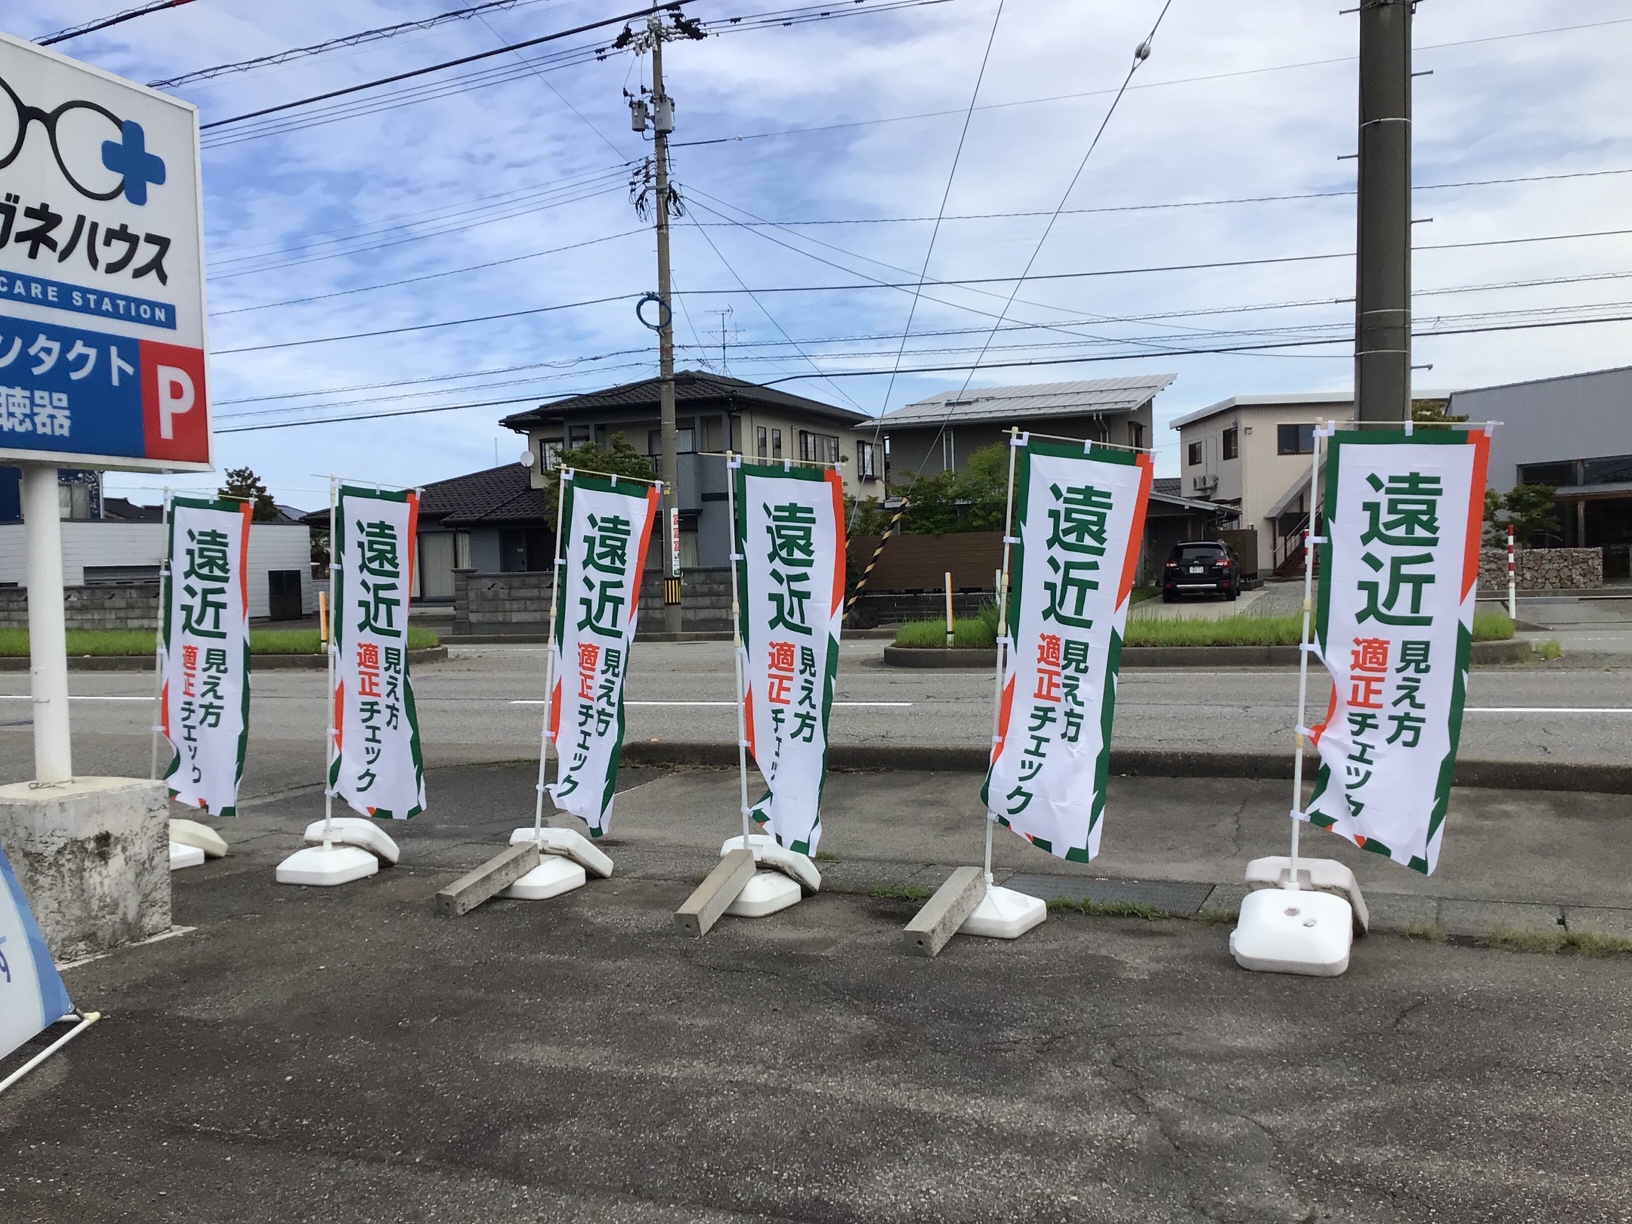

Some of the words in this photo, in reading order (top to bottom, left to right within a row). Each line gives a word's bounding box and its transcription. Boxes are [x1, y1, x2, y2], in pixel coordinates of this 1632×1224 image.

[72, 291, 167, 322] STATION
[156, 363, 195, 440] P
[181, 528, 231, 640] 遠近
[356, 520, 401, 639] 遠近
[577, 512, 633, 640] 遠近
[763, 502, 817, 636] 遠近
[1042, 483, 1113, 630] 遠近
[1355, 472, 1443, 627] 遠近
[199, 647, 229, 728] 見え方
[357, 642, 382, 793] 適正チェック
[384, 646, 402, 731] 見え方
[557, 643, 600, 799] 適正チェック
[596, 648, 621, 738] 見え方
[793, 646, 817, 743] 見え方
[1007, 633, 1061, 815] 適正チェック
[1061, 639, 1090, 743] 見え方
[1385, 640, 1431, 749] 見え方
